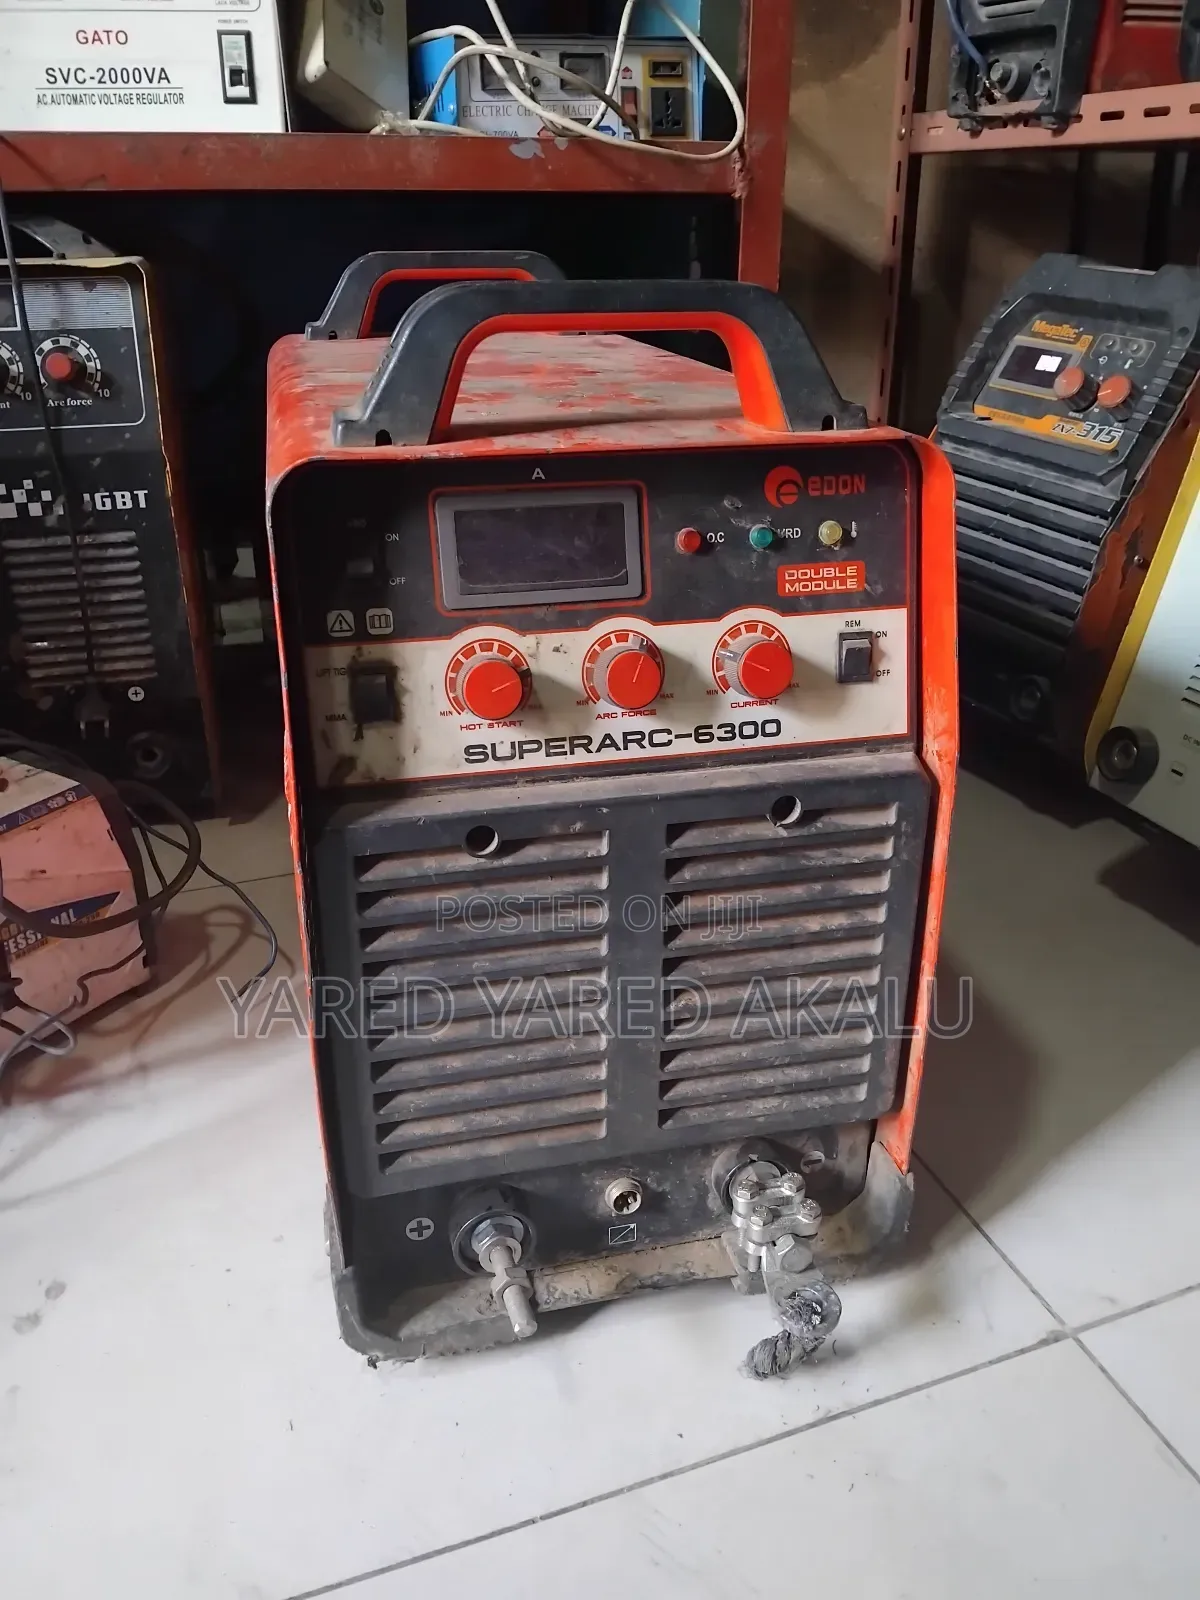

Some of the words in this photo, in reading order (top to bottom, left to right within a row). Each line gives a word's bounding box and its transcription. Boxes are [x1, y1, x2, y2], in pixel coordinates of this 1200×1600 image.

[75, 29, 129, 46] GATO
[45, 66, 172, 86] SVC-2000VA
[97, 93, 135, 106] VOLTAGE
[135, 92, 185, 105] REGULATOR
[462, 104, 513, 118] ELECTRIC
[20, 392, 32, 401] 10
[98, 388, 111, 398] 10
[47, 399, 66, 407] Arc
[66, 397, 93, 406] force
[531, 467, 546, 480] A
[385, 532, 400, 542] ON
[784, 566, 858, 581] DOUBLE
[389, 576, 406, 586] OFF
[784, 578, 858, 593] MODULE
[844, 619, 862, 629] REM
[876, 630, 888, 639] ON
[875, 668, 892, 678] OFF
[576, 699, 590, 707] MIN
[730, 699, 779, 709] CURRENT
[439, 710, 454, 718] MIN
[595, 711, 619, 721] ARC
[621, 708, 658, 718] FORCE
[459, 723, 484, 731] HOT
[487, 719, 524, 729] START
[463, 718, 782, 764] SUPERARC-6300
